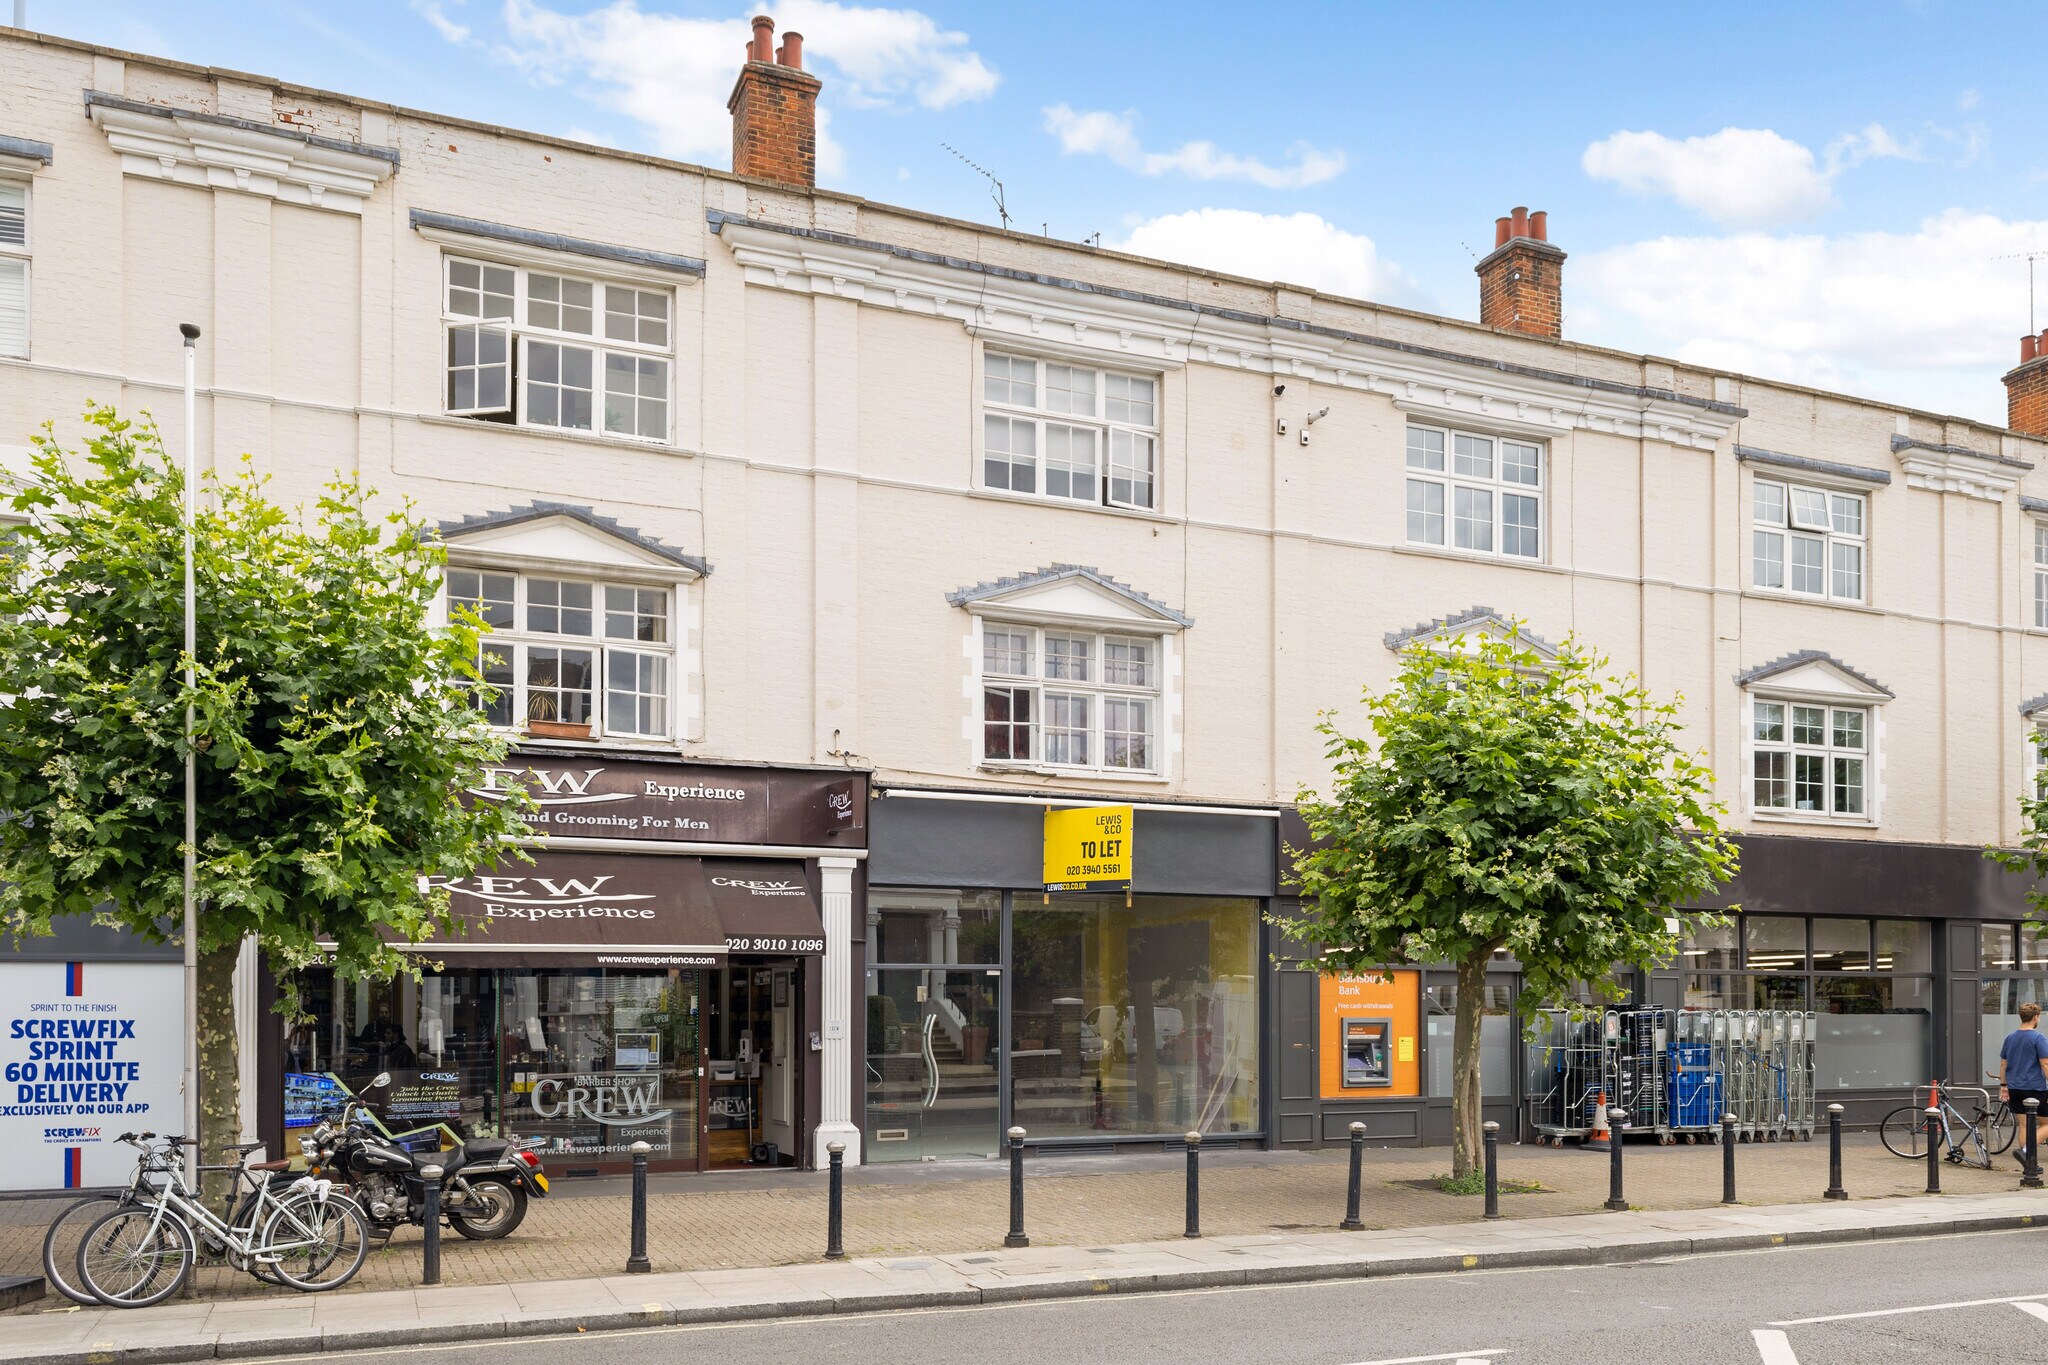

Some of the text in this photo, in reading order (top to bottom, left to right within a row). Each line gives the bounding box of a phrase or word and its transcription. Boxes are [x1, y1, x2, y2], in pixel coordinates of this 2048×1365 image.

[644, 780, 746, 802] Experience
[829, 790, 851, 808] CREW
[519, 811, 710, 830] and Grooming For Men
[1096, 815, 1122, 826] LEWIS
[1104, 825, 1122, 835] &CO
[1081, 840, 1122, 859] TO LET
[1066, 864, 1121, 876] 020 3940 5561
[414, 875, 616, 899] REW
[711, 877, 797, 890] CREW
[1047, 882, 1087, 892] LEWISCO.CO.UK
[751, 889, 806, 897] Experience
[483, 903, 656, 922] Experience
[753, 939, 787, 951] 3010
[791, 939, 823, 951] 1096
[311, 954, 326, 965] 20
[597, 955, 716, 966] www.crewexperience.com
[1338, 985, 1361, 995] Bank
[30, 1004, 117, 1012] SPRINT TO THE FINISH
[10, 1019, 136, 1039] SCREWFIX
[29, 1041, 118, 1060] SPRINT
[5, 1062, 140, 1082] 60 MINUTE
[420, 1072, 456, 1080] CREW
[577, 1078, 637, 1086] BARBER SHOP
[18, 1083, 129, 1103] DELIVERY
[531, 1079, 664, 1121] CREW
[0, 1103, 150, 1116] XCLUSIVELY ON OUR APP
[44, 1127, 101, 1138] SCREWFIX
[620, 1127, 670, 1138] Experience
